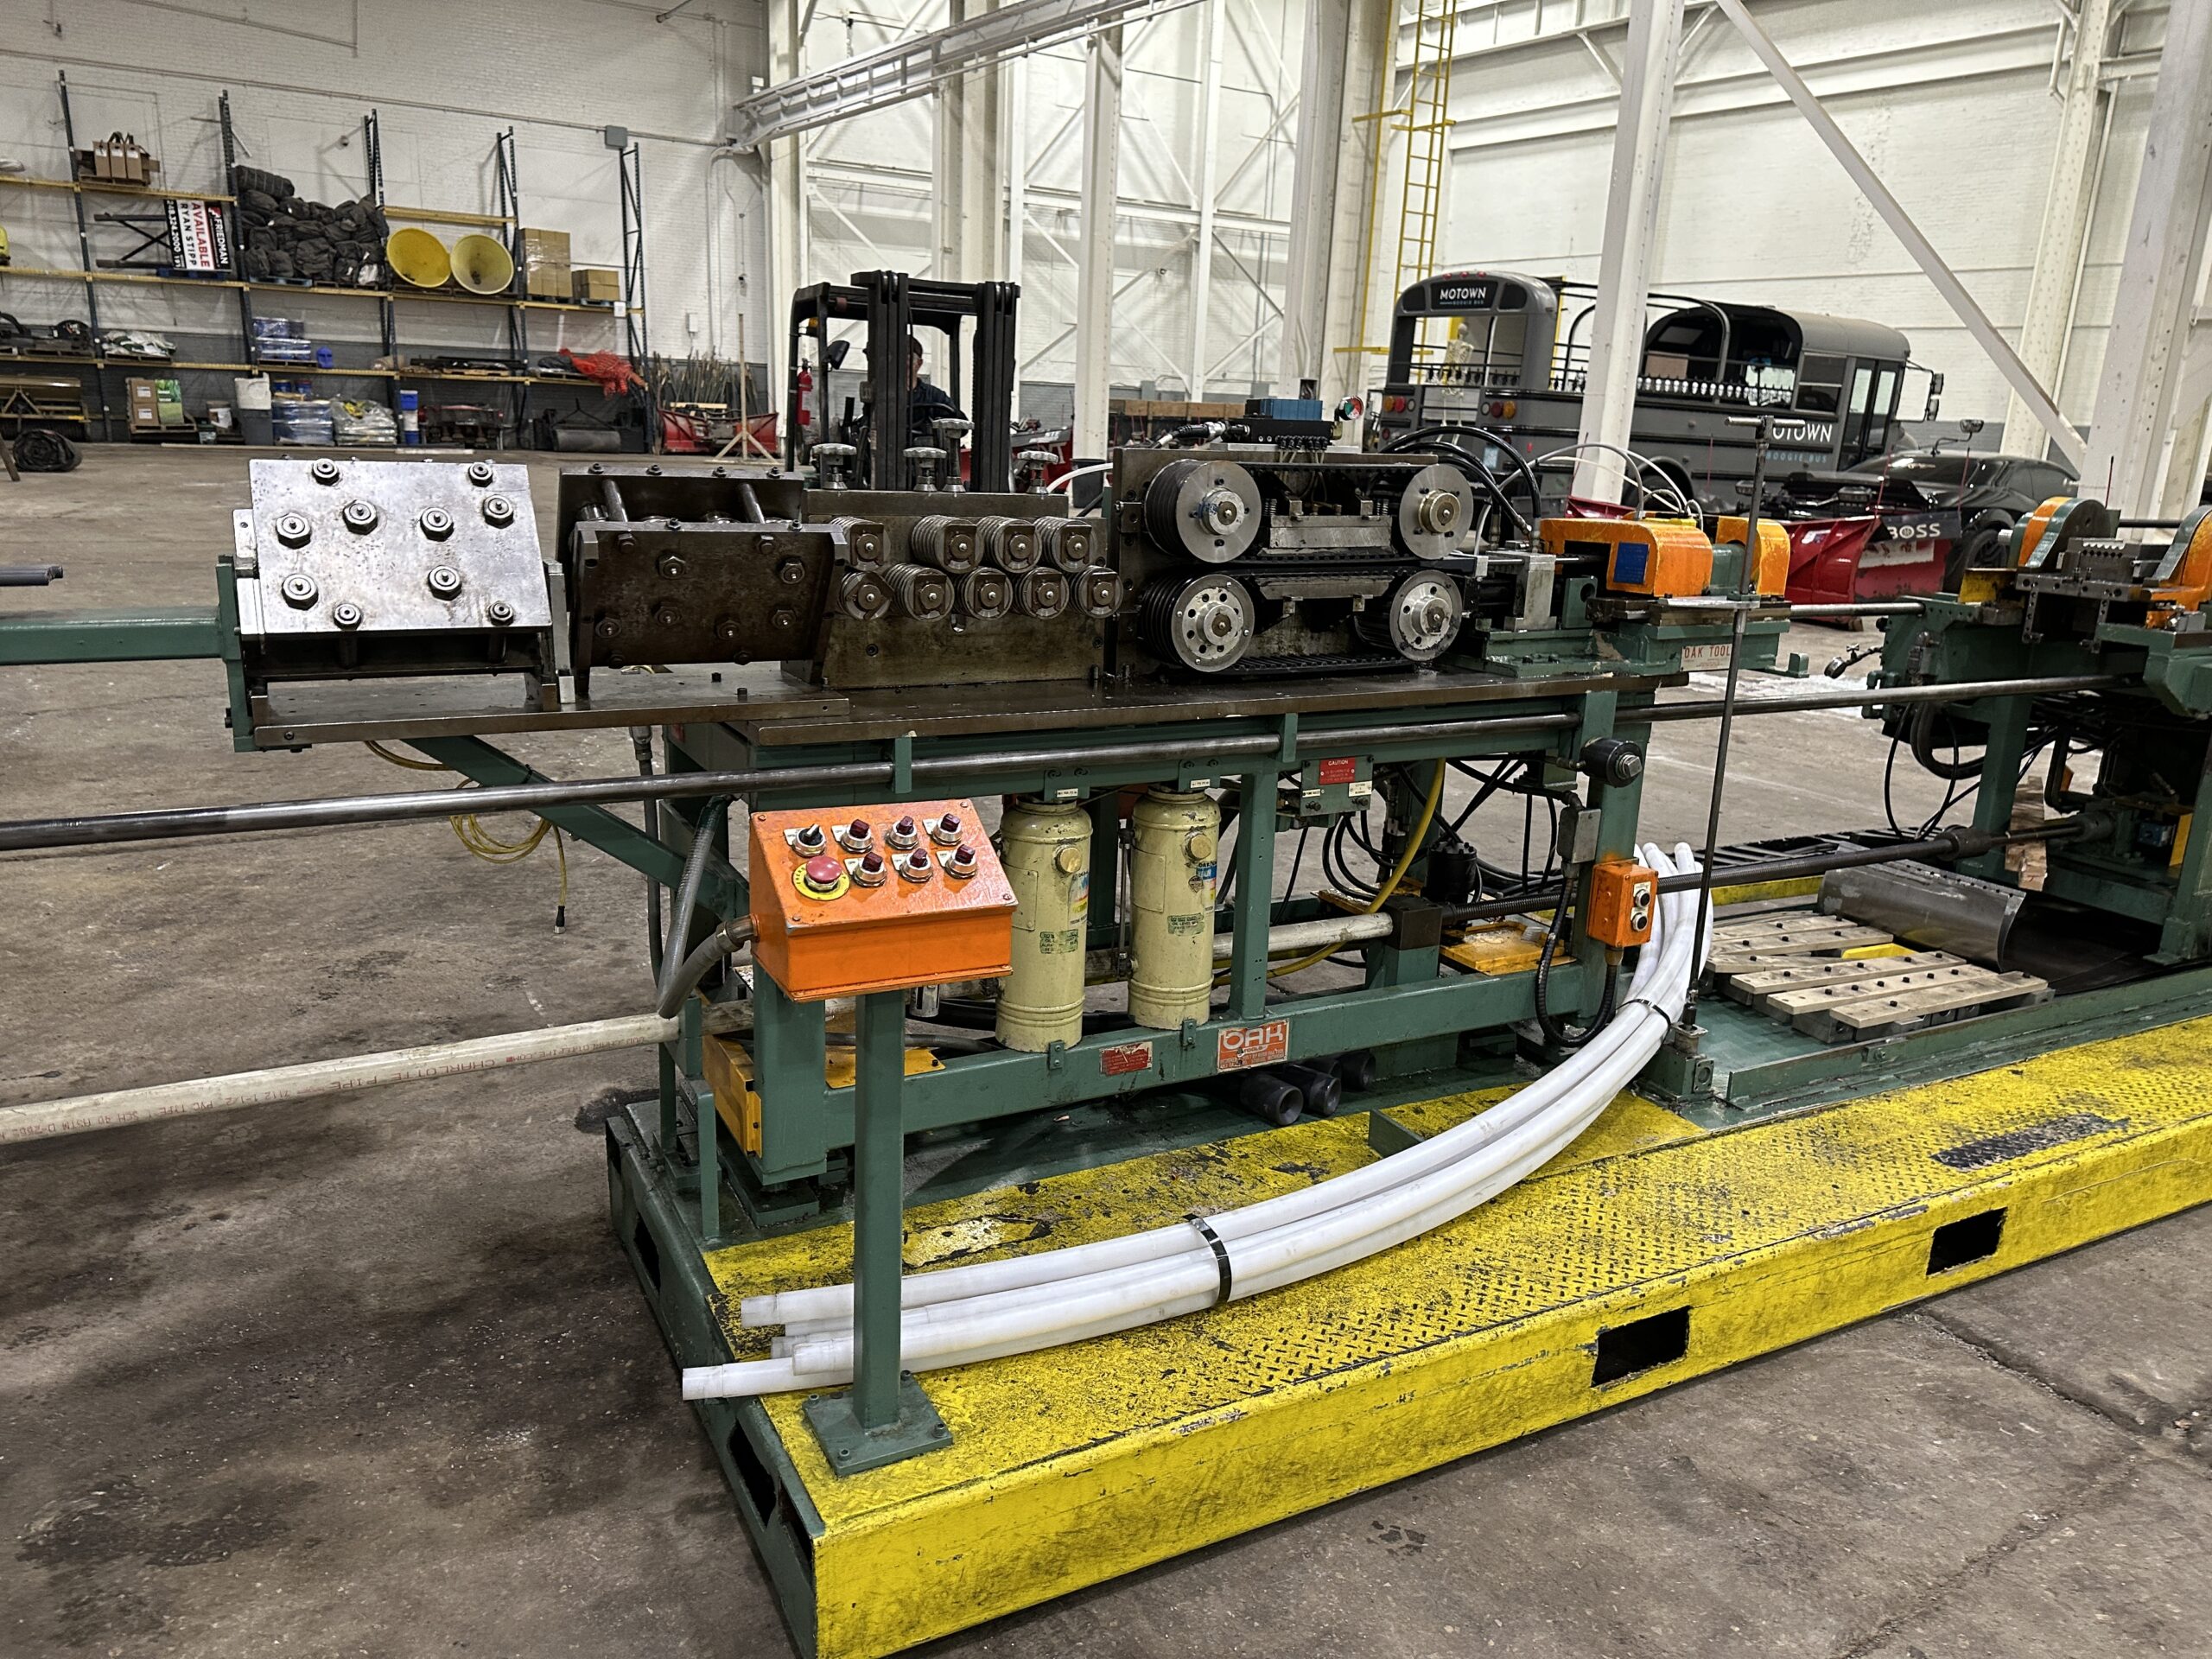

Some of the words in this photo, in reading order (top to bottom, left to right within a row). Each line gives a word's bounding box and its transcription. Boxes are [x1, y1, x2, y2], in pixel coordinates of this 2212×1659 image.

[180, 202, 191, 232] RYAN
[186, 236, 197, 265] STIPP
[191, 201, 210, 267] AVAILABLE
[213, 218, 228, 264] FRIEDMAN
[1440, 287, 1486, 299] MOTOWN
[1771, 423, 1833, 442] OTOWN
[1765, 452, 1803, 461] BOOGIE
[1808, 454, 1827, 463] BUS
[1886, 522, 1942, 540] BOSS
[1684, 646, 1703, 658] OAK
[1223, 1024, 1284, 1050] OAK
